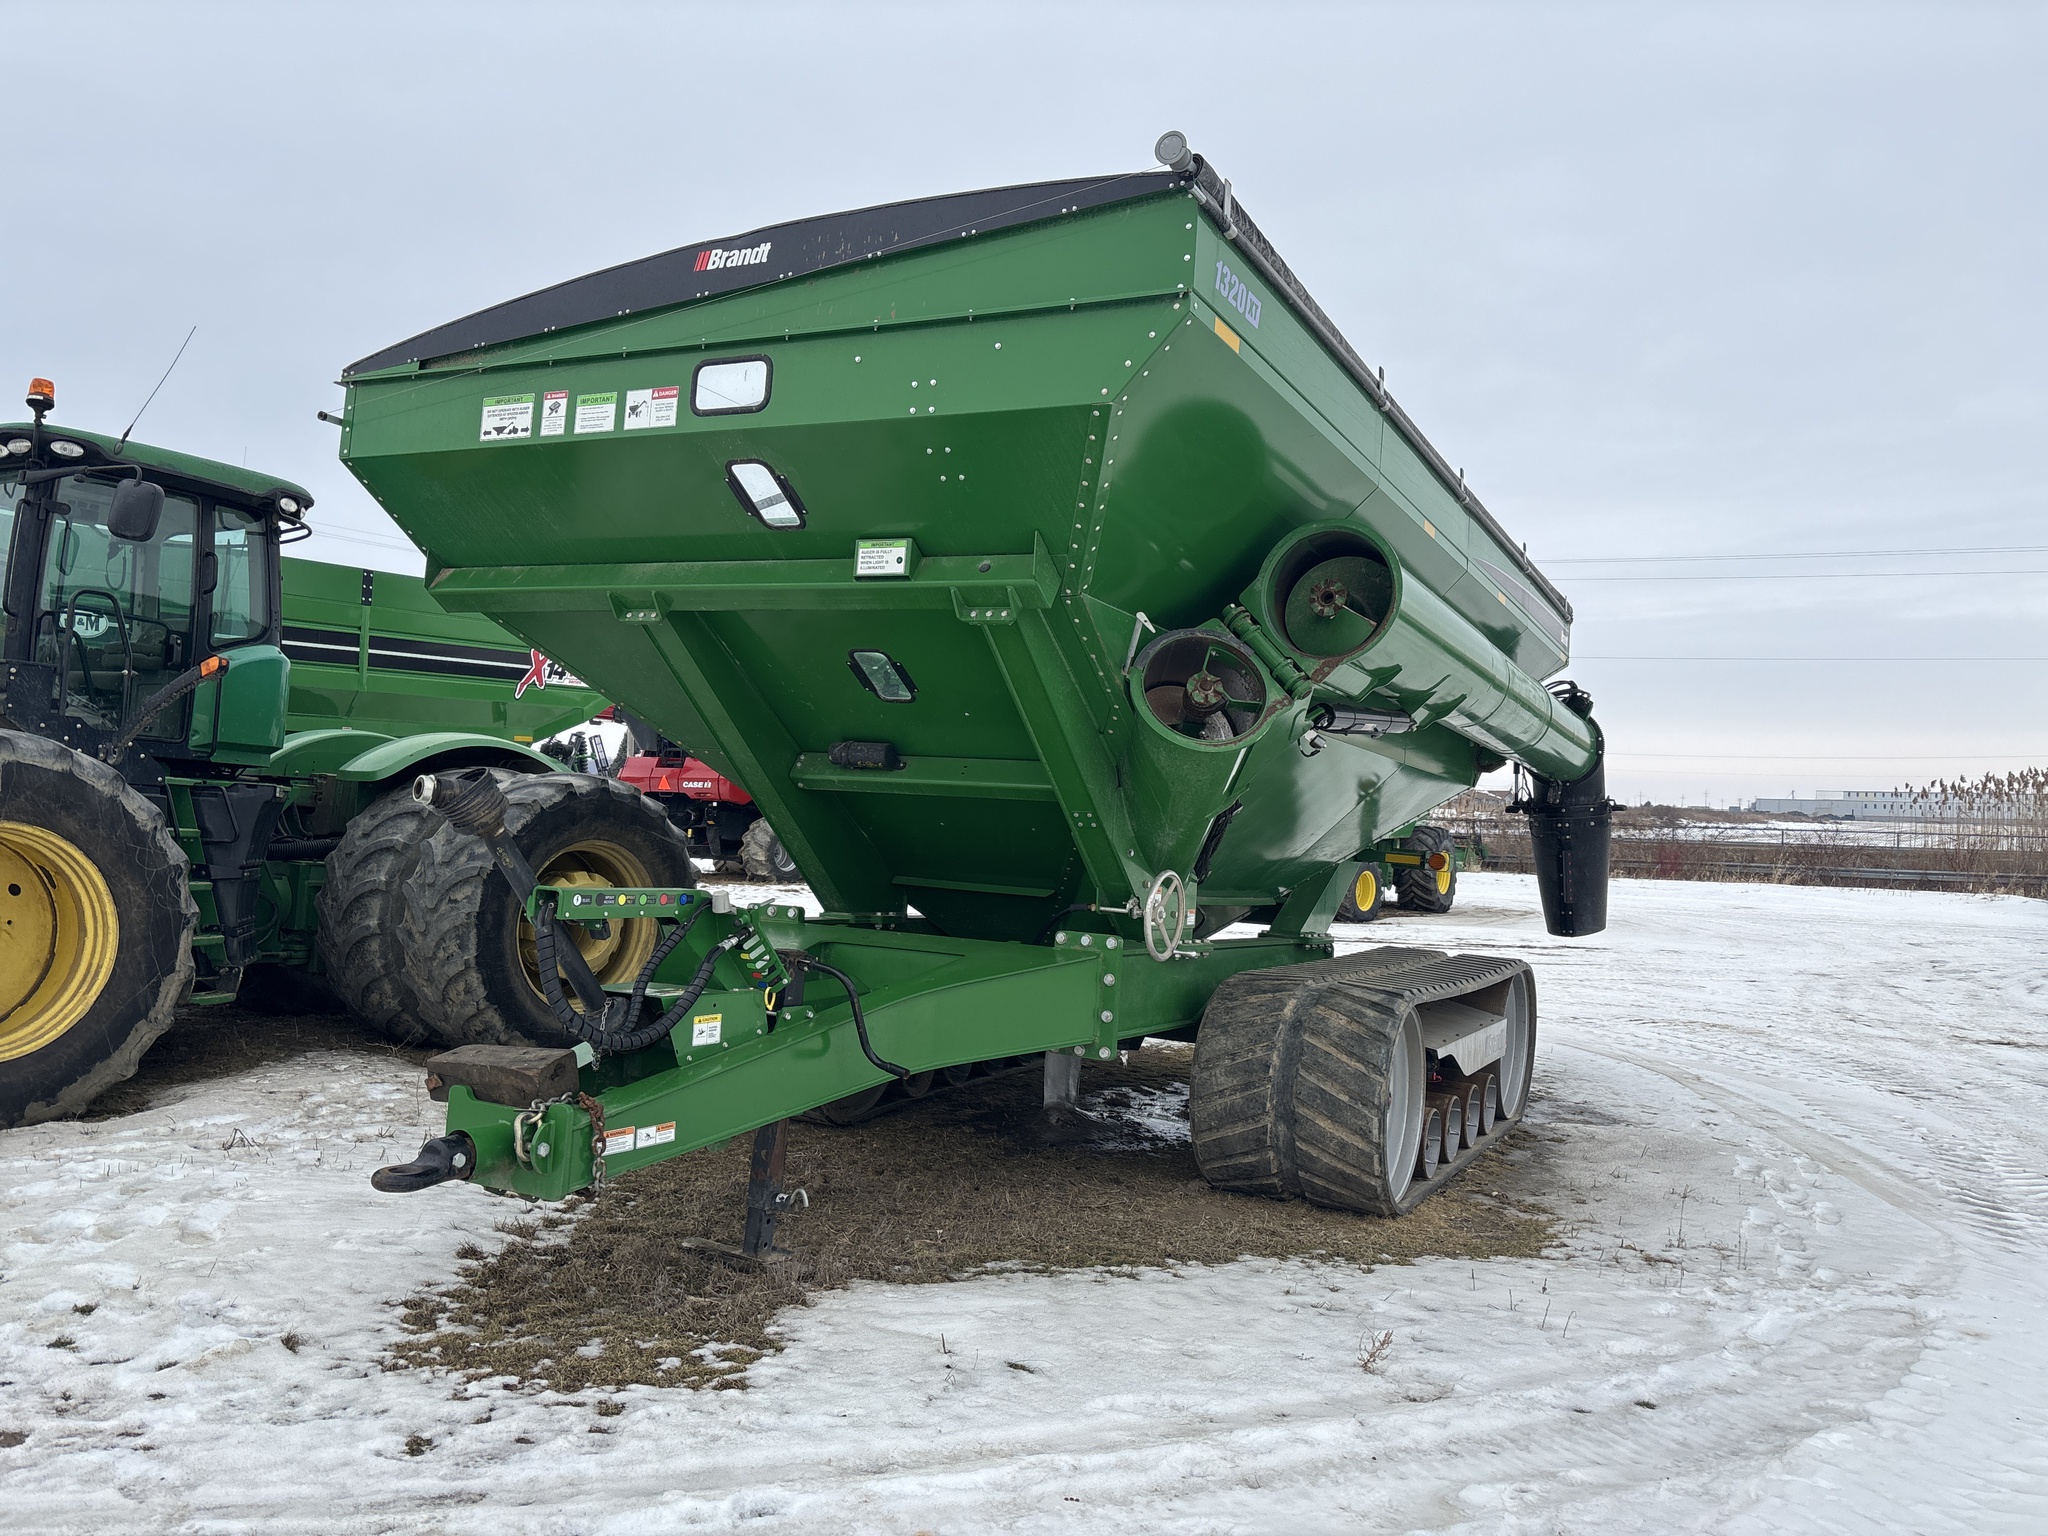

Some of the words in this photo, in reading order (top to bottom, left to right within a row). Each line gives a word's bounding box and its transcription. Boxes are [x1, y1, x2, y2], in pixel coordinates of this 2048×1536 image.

[706, 242, 772, 271] Brandt
[495, 397, 524, 405] IMPORTANT
[580, 396, 615, 405] IMPORTANT
